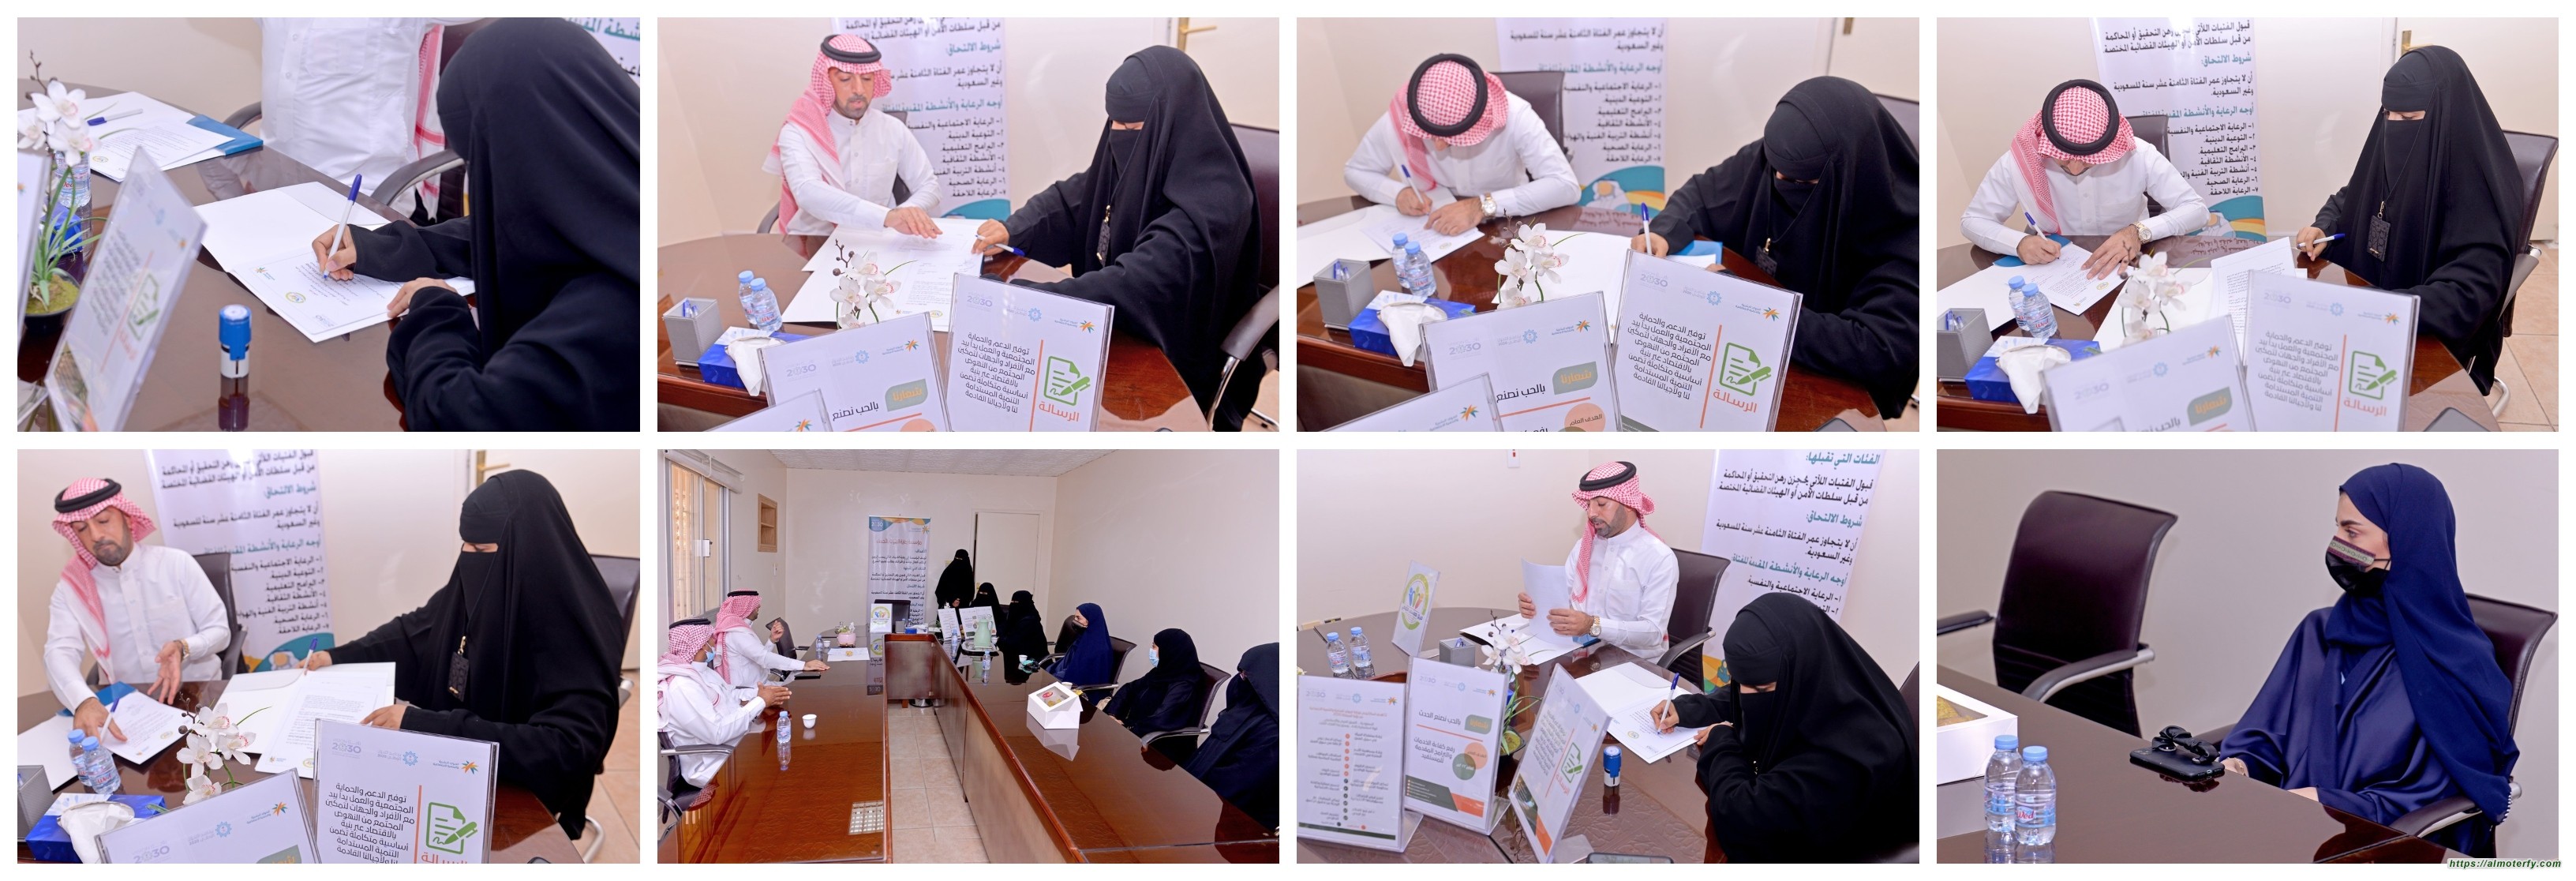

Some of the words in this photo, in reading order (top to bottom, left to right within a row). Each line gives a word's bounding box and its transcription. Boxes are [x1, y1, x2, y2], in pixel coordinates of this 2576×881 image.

[2232, 51, 2251, 65] شروط
[2169, 77, 2188, 87] الثامنة
[2248, 71, 2252, 83] أن
[2114, 81, 2140, 91] للسعودية
[2242, 87, 2253, 96] وغير
[2184, 105, 2215, 118] والأنشطة
[2216, 106, 2237, 116] الرعاية
[2240, 102, 2253, 115] أوجه
[2196, 124, 2226, 134] الاجتماعية
[2228, 122, 2246, 132] الرعاية
[2226, 133, 2247, 143] التوعية
[2230, 145, 2248, 155] البرامج
[2225, 153, 2248, 163] الأنشطة
[2192, 169, 2208, 178] الفنية
[2211, 167, 2227, 176] التربية
[2230, 163, 2249, 173] أنشطة
[2232, 176, 2249, 185] الرعاية
[1639, 313, 1665, 328] والحماية
[1628, 327, 1649, 339] لتمكين
[1651, 325, 1674, 339] والعمل
[1666, 324, 1686, 333] الدعم
[1687, 329, 1706, 339] توفير
[1635, 339, 1659, 351] النهوض
[1650, 334, 1676, 350] والجهات
[1676, 334, 1711, 351] المجتمعية
[1640, 348, 1651, 359] بنية
[1678, 345, 1698, 356] الأفراد
[1629, 353, 1646, 364] تضمن
[1671, 352, 1699, 366] المجتمع
[1647, 360, 1672, 375] متكاملة
[1663, 358, 1691, 373] بالاقتصاد
[1561, 369, 1592, 385] شعارنا
[1634, 363, 1668, 382] المستدامة
[1675, 370, 1702, 385] أساسية
[1634, 372, 1656, 386] القادمة
[1670, 377, 1692, 391] التنمية
[1522, 384, 1545, 398] بالحب
[1657, 381, 1682, 397] ولأجيالنا
[1496, 388, 1519, 403] نصنع
[1713, 388, 1757, 413] الرسالة
[856, 402, 878, 414] بالحب
[1039, 401, 1080, 422] الرسالة
[833, 409, 853, 422] نصنع
[1585, 414, 1602, 424] الهدف
[1833, 452, 1852, 470] التي
[1854, 453, 1880, 464] الفئات
[1724, 469, 1747, 478] المحاكمة
[1747, 468, 1753, 482] أو
[1753, 472, 1775, 482] التحقيق
[1775, 474, 1786, 484] رهن
[1743, 483, 1766, 494] القضائية
[1829, 478, 1855, 489] الفتيات
[1856, 479, 1874, 492] قبول
[1767, 486, 1790, 498] الهيئات
[1790, 484, 1798, 499] أو
[1798, 487, 1814, 500] الأمن
[1815, 491, 1842, 501] سلطات
[1844, 493, 1859, 505] قبل
[1717, 519, 1740, 530] للسعودية
[1742, 522, 1752, 532] سنة
[1840, 515, 1863, 528] شروط
[1753, 524, 1763, 535] عشر
[1765, 529, 1787, 538] الثامنة
[1788, 530, 1807, 541] الفتاة
[1821, 537, 1843, 549] يتجاوز
[1845, 539, 1849, 548] لا
[1850, 538, 1858, 551] أن
[1749, 557, 1768, 569] المقدمة
[1840, 553, 1853, 565] وغير
[1769, 560, 1802, 578] والأنشطة
[1804, 567, 1829, 583] الرعاية
[1830, 572, 1848, 587] أوجه
[1776, 579, 1810, 595] الاجتماعية
[1811, 588, 1833, 602] الرعاية
[1419, 710, 1433, 718] الحدث
[1413, 737, 1431, 746] الخدمات
[1415, 744, 1433, 753] المقدمة
[1434, 750, 1452, 759] والبرامج
[1421, 754, 1443, 763] للمستفيد
[336, 782, 364, 796] والحماية
[388, 794, 406, 804] توفير
[2016, 809, 2035, 819] Wed
